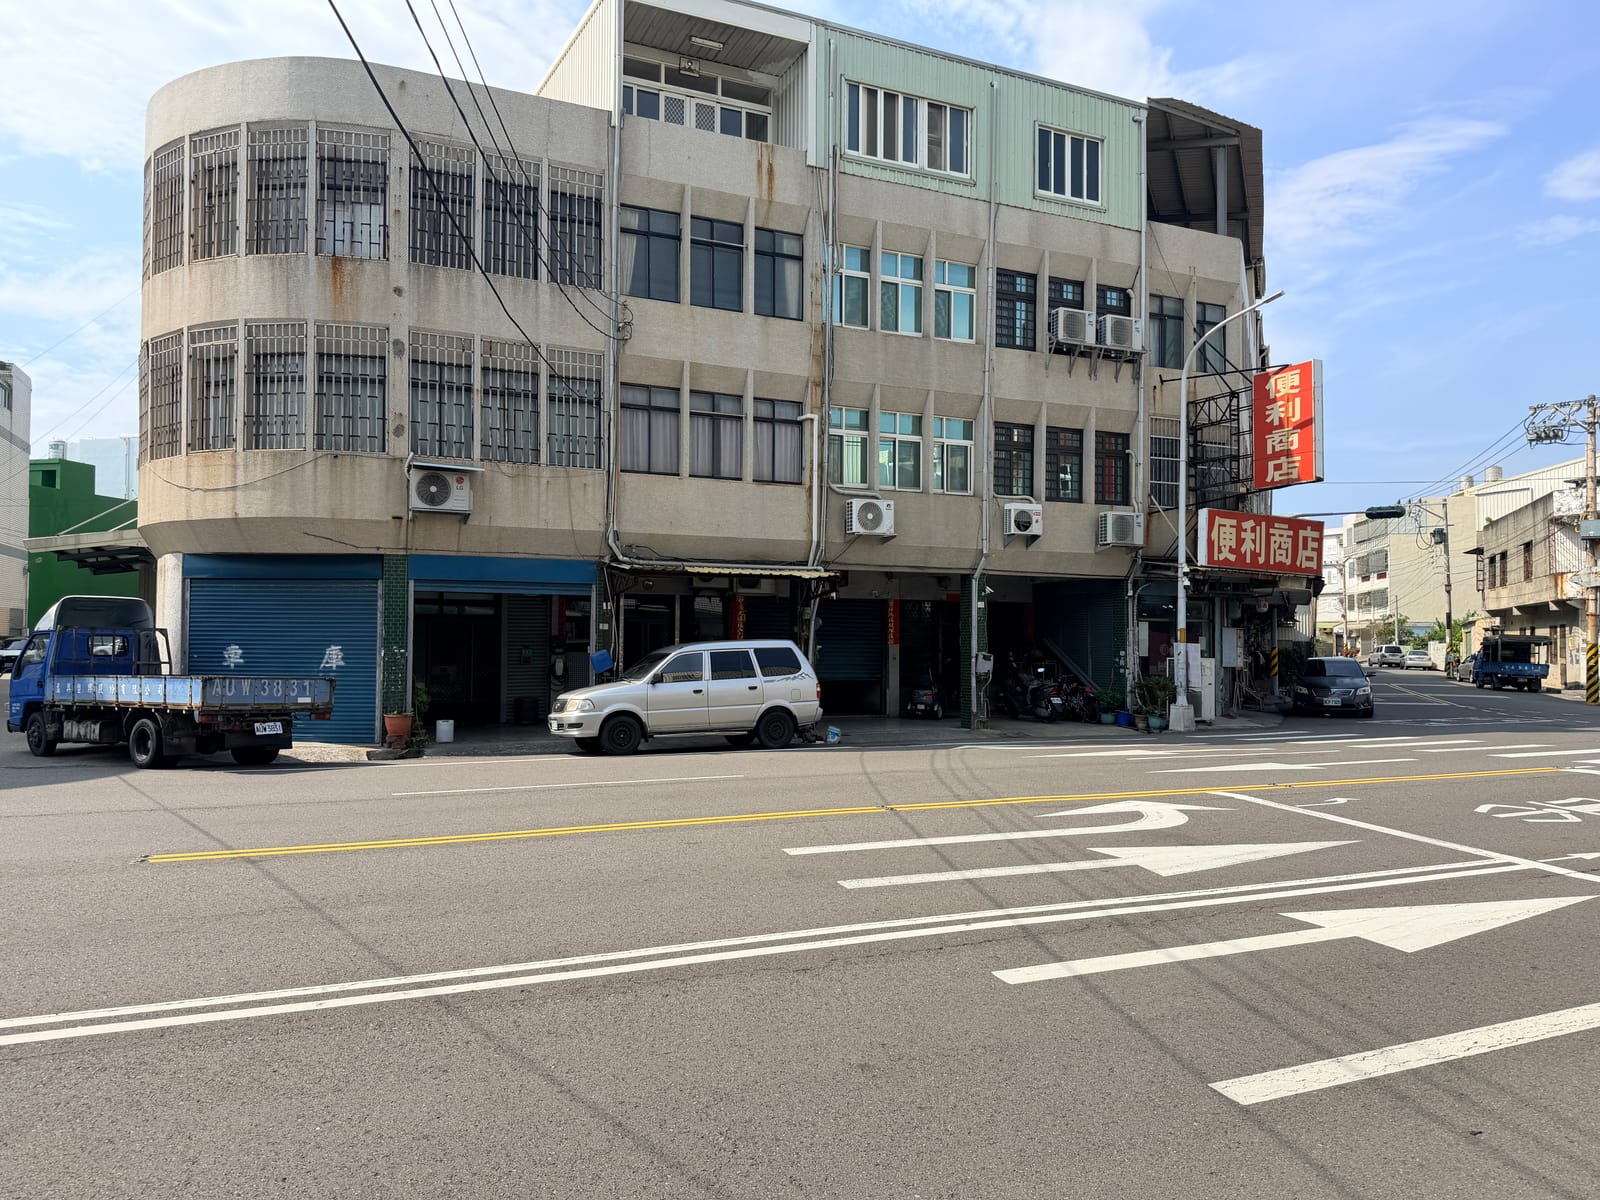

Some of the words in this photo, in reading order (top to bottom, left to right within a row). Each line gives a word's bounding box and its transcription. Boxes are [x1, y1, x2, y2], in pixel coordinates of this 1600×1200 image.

[1265, 369, 1301, 483] 便利商店
[1211, 515, 1320, 570] 便利商店
